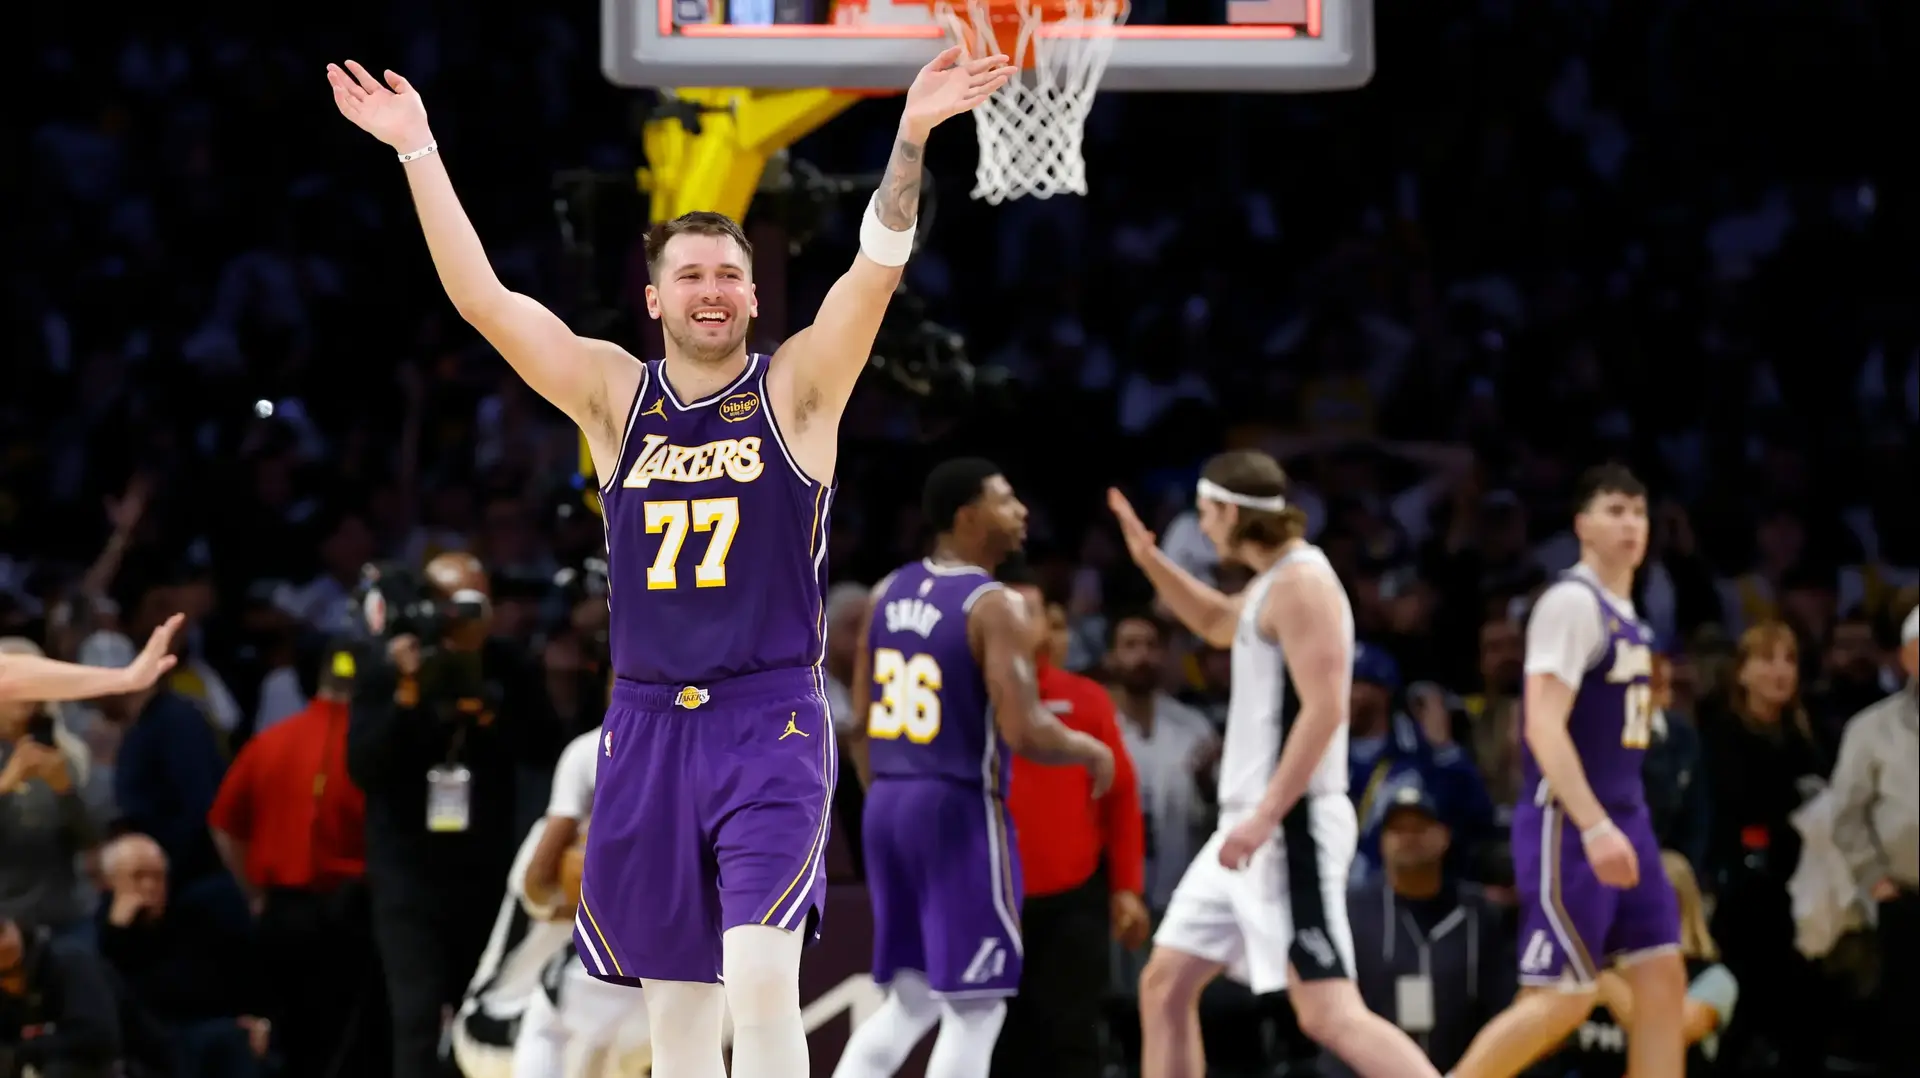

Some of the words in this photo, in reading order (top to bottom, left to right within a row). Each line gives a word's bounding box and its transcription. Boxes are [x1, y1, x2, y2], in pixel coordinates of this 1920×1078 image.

[723, 399, 757, 413] bibigo
[622, 434, 765, 489] LAKERS
[643, 497, 740, 590] 77
[866, 648, 943, 745] 36
